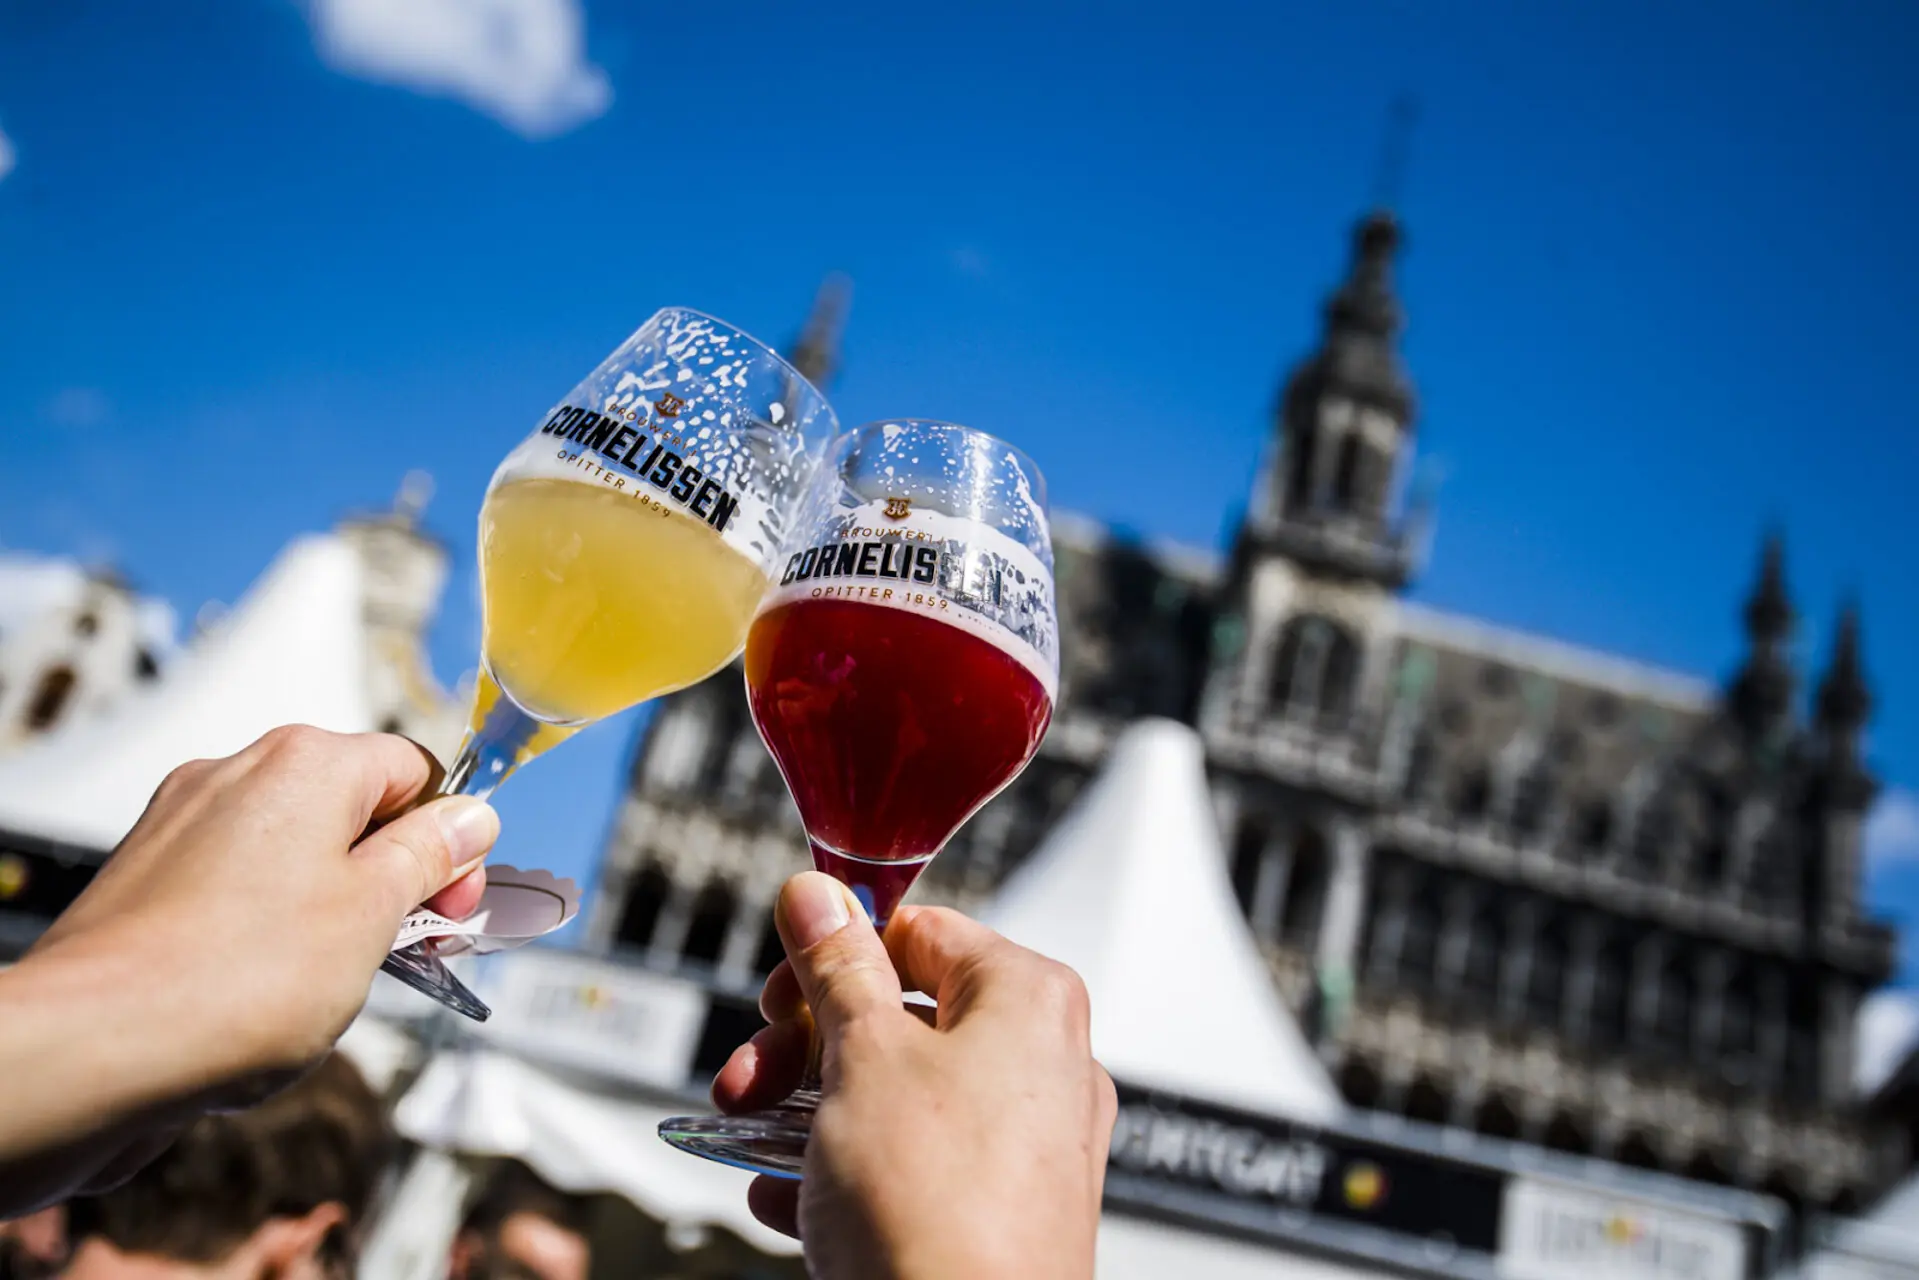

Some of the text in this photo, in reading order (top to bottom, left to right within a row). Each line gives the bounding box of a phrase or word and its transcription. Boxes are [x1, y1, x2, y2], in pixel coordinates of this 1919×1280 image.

[542, 405, 737, 532] CORNELISSEN
[557, 449, 672, 518] OPITTER 1859
[812, 585, 948, 609] OPITTER 1859
